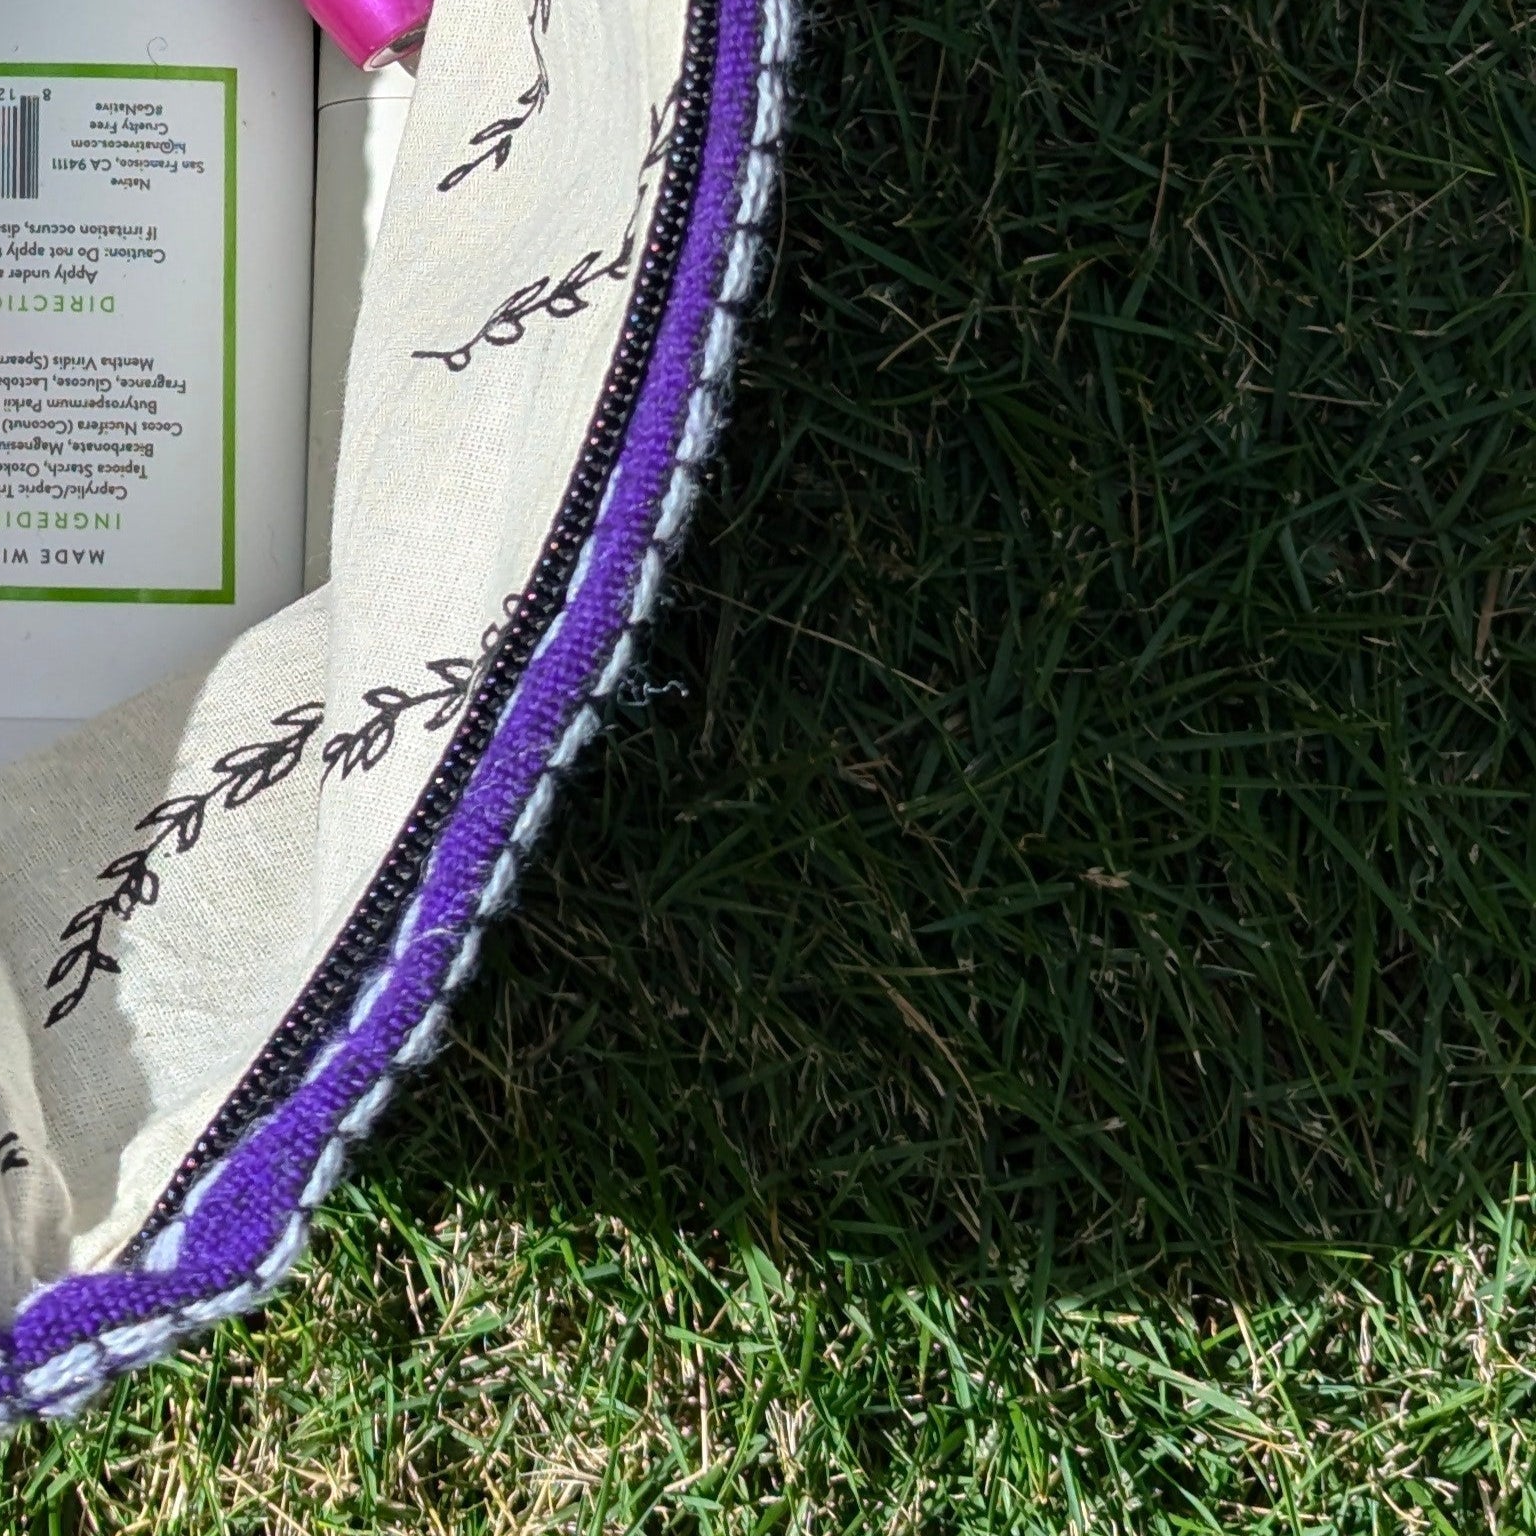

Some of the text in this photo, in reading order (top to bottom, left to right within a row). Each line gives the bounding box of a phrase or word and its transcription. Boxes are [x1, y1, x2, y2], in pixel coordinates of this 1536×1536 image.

[43, 89, 51, 101] 8
[96, 102, 163, 115] #GoNative
[90, 119, 168, 134] Cruelty Free
[52, 157, 204, 173] San Francisco, CA 94111
[111, 177, 150, 190] Native
[24, 221, 75, 236] occurs,
[80, 225, 143, 239] irritation
[144, 226, 157, 240] If
[7, 243, 45, 260] apply
[49, 247, 73, 260] not
[78, 247, 99, 261] Do
[104, 247, 165, 262] Caution:
[9, 268, 50, 283] under
[55, 265, 98, 283] Apply
[53, 356, 97, 370] Viridis
[101, 357, 154, 371] Mentha
[52, 376, 112, 392] Glucose,
[116, 375, 186, 393] Fragrance,
[4, 400, 42, 413] Parkii
[47, 396, 157, 414] Butyrospermum
[3, 418, 73, 434] (Coconut)
[78, 421, 137, 435] Nucifera
[141, 422, 182, 436] Cocos
[68, 439, 154, 456] Bicarbonate,
[44, 462, 93, 477] Starch,
[98, 461, 148, 478] Tapioca
[19, 482, 127, 499] Caprylic/Capric
[40, 549, 104, 563] MADE
